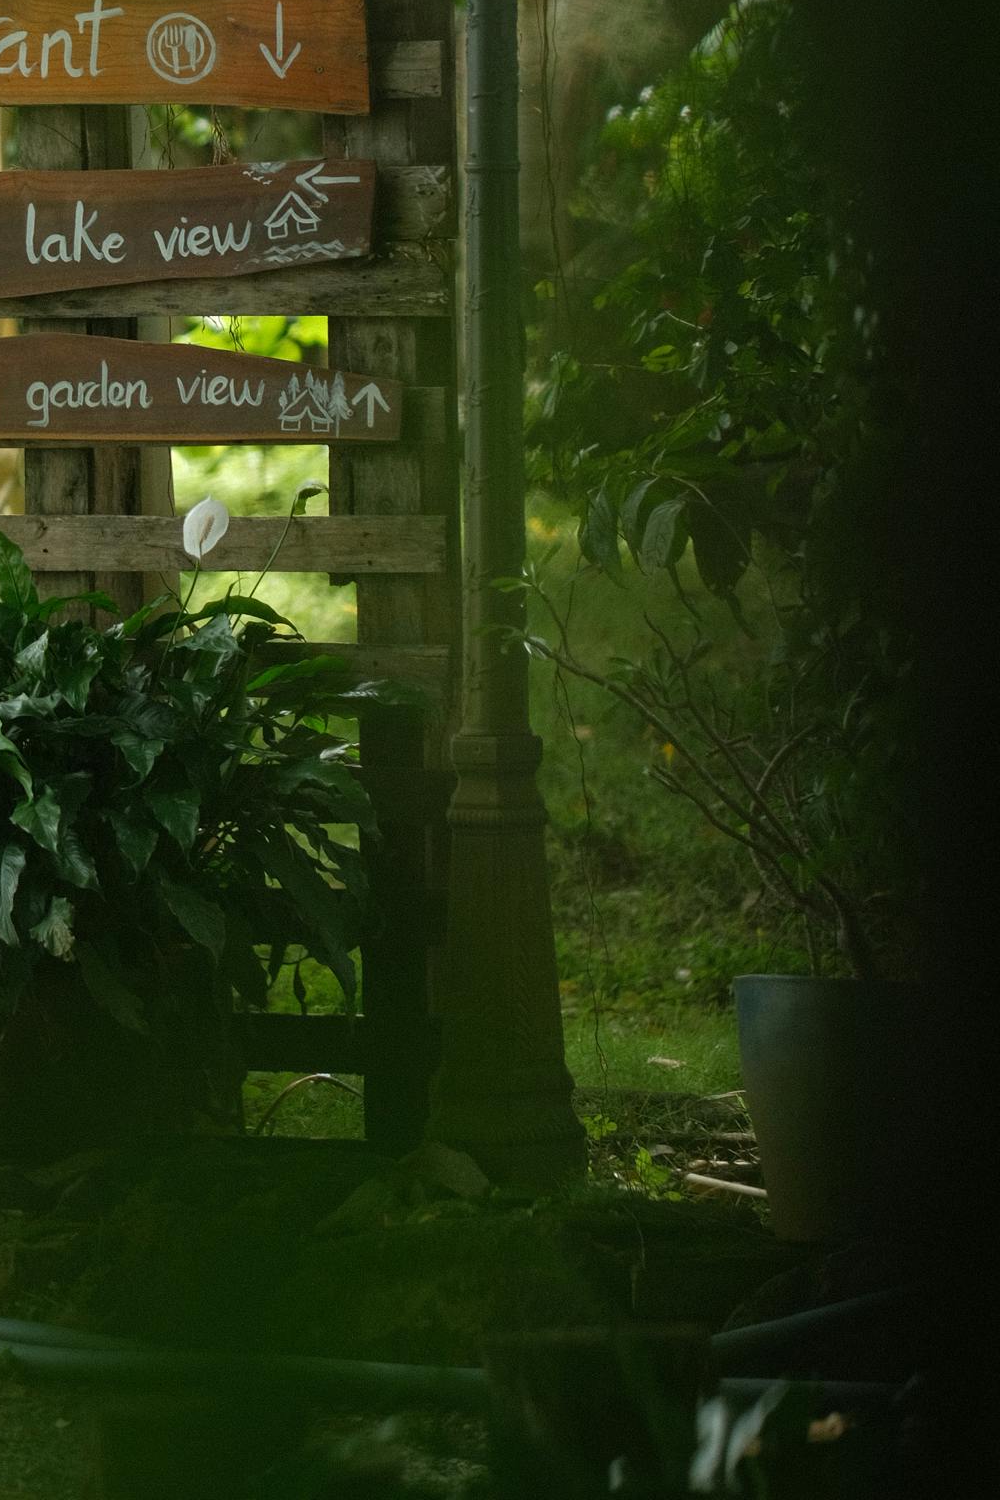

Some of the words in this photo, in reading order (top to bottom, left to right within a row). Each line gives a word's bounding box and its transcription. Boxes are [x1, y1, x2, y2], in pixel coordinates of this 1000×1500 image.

[154, 216, 253, 262] view
[25, 361, 153, 427] garden
[176, 368, 267, 407] view
